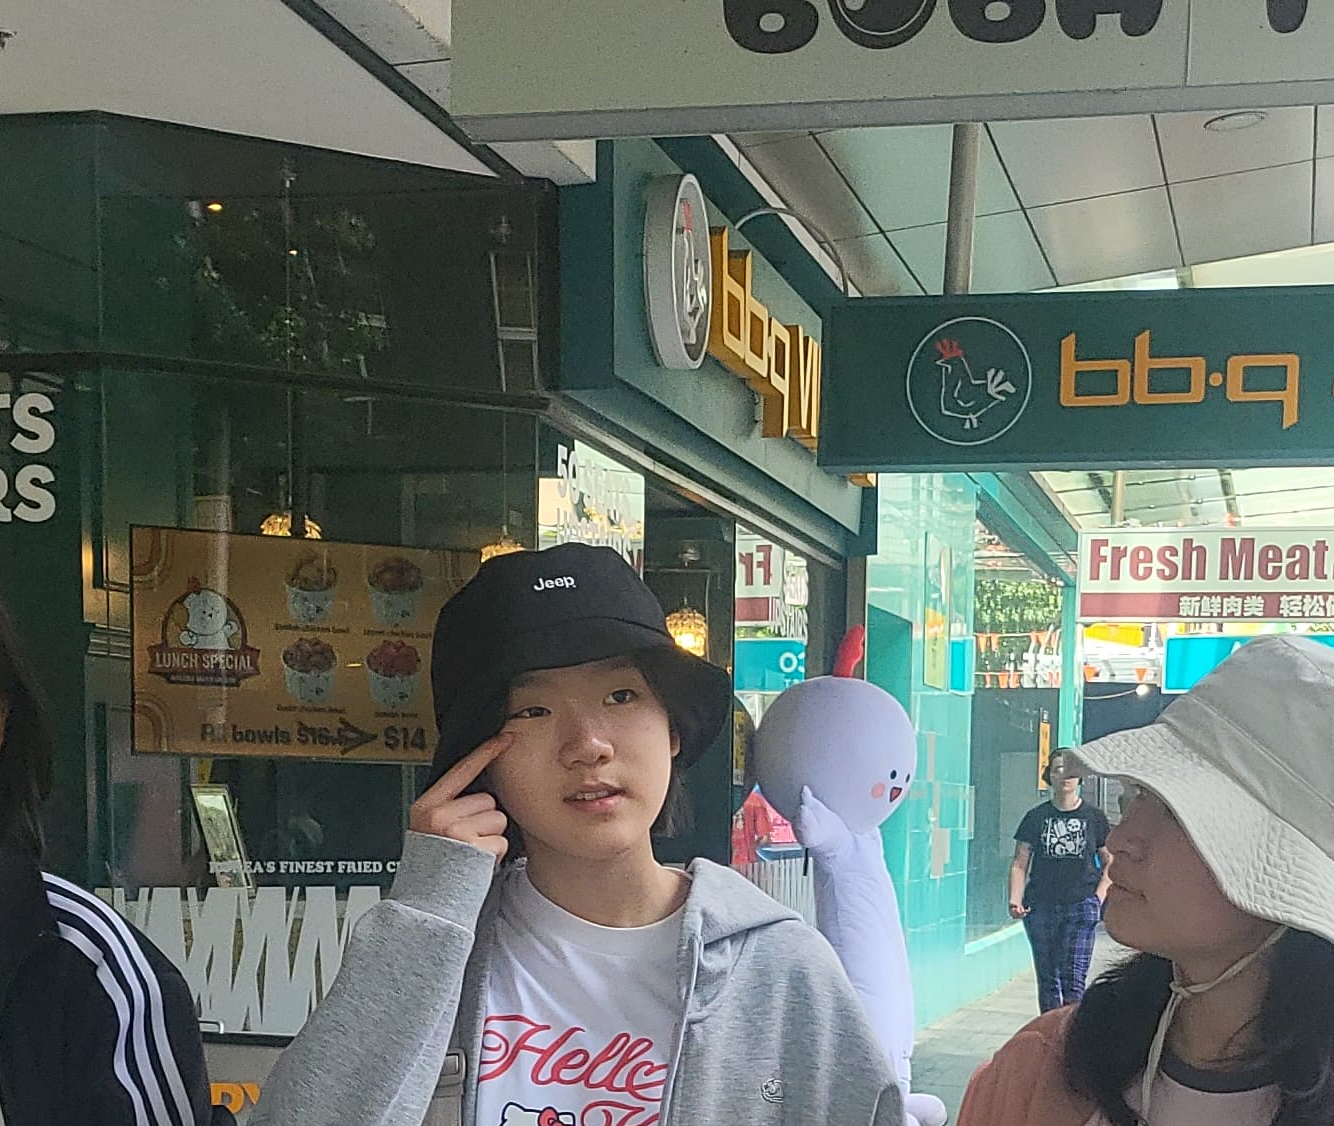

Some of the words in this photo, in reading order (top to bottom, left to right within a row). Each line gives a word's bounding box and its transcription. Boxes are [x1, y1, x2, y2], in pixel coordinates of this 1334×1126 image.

[1088, 537, 1208, 582] Fresh
[1218, 536, 1329, 581] Meat
[533, 576, 575, 591] Jeep
[1178, 595, 1265, 617] 新鲜肉类
[155, 652, 198, 668] LUNCH
[202, 653, 255, 671] SPECIAL
[232, 723, 292, 744] bowls
[384, 725, 427, 752] $14
[209, 861, 276, 874] KEA'S
[280, 861, 334, 873] FINEST
[337, 861, 383, 874] FRIED
[478, 1014, 668, 1101] Hello
